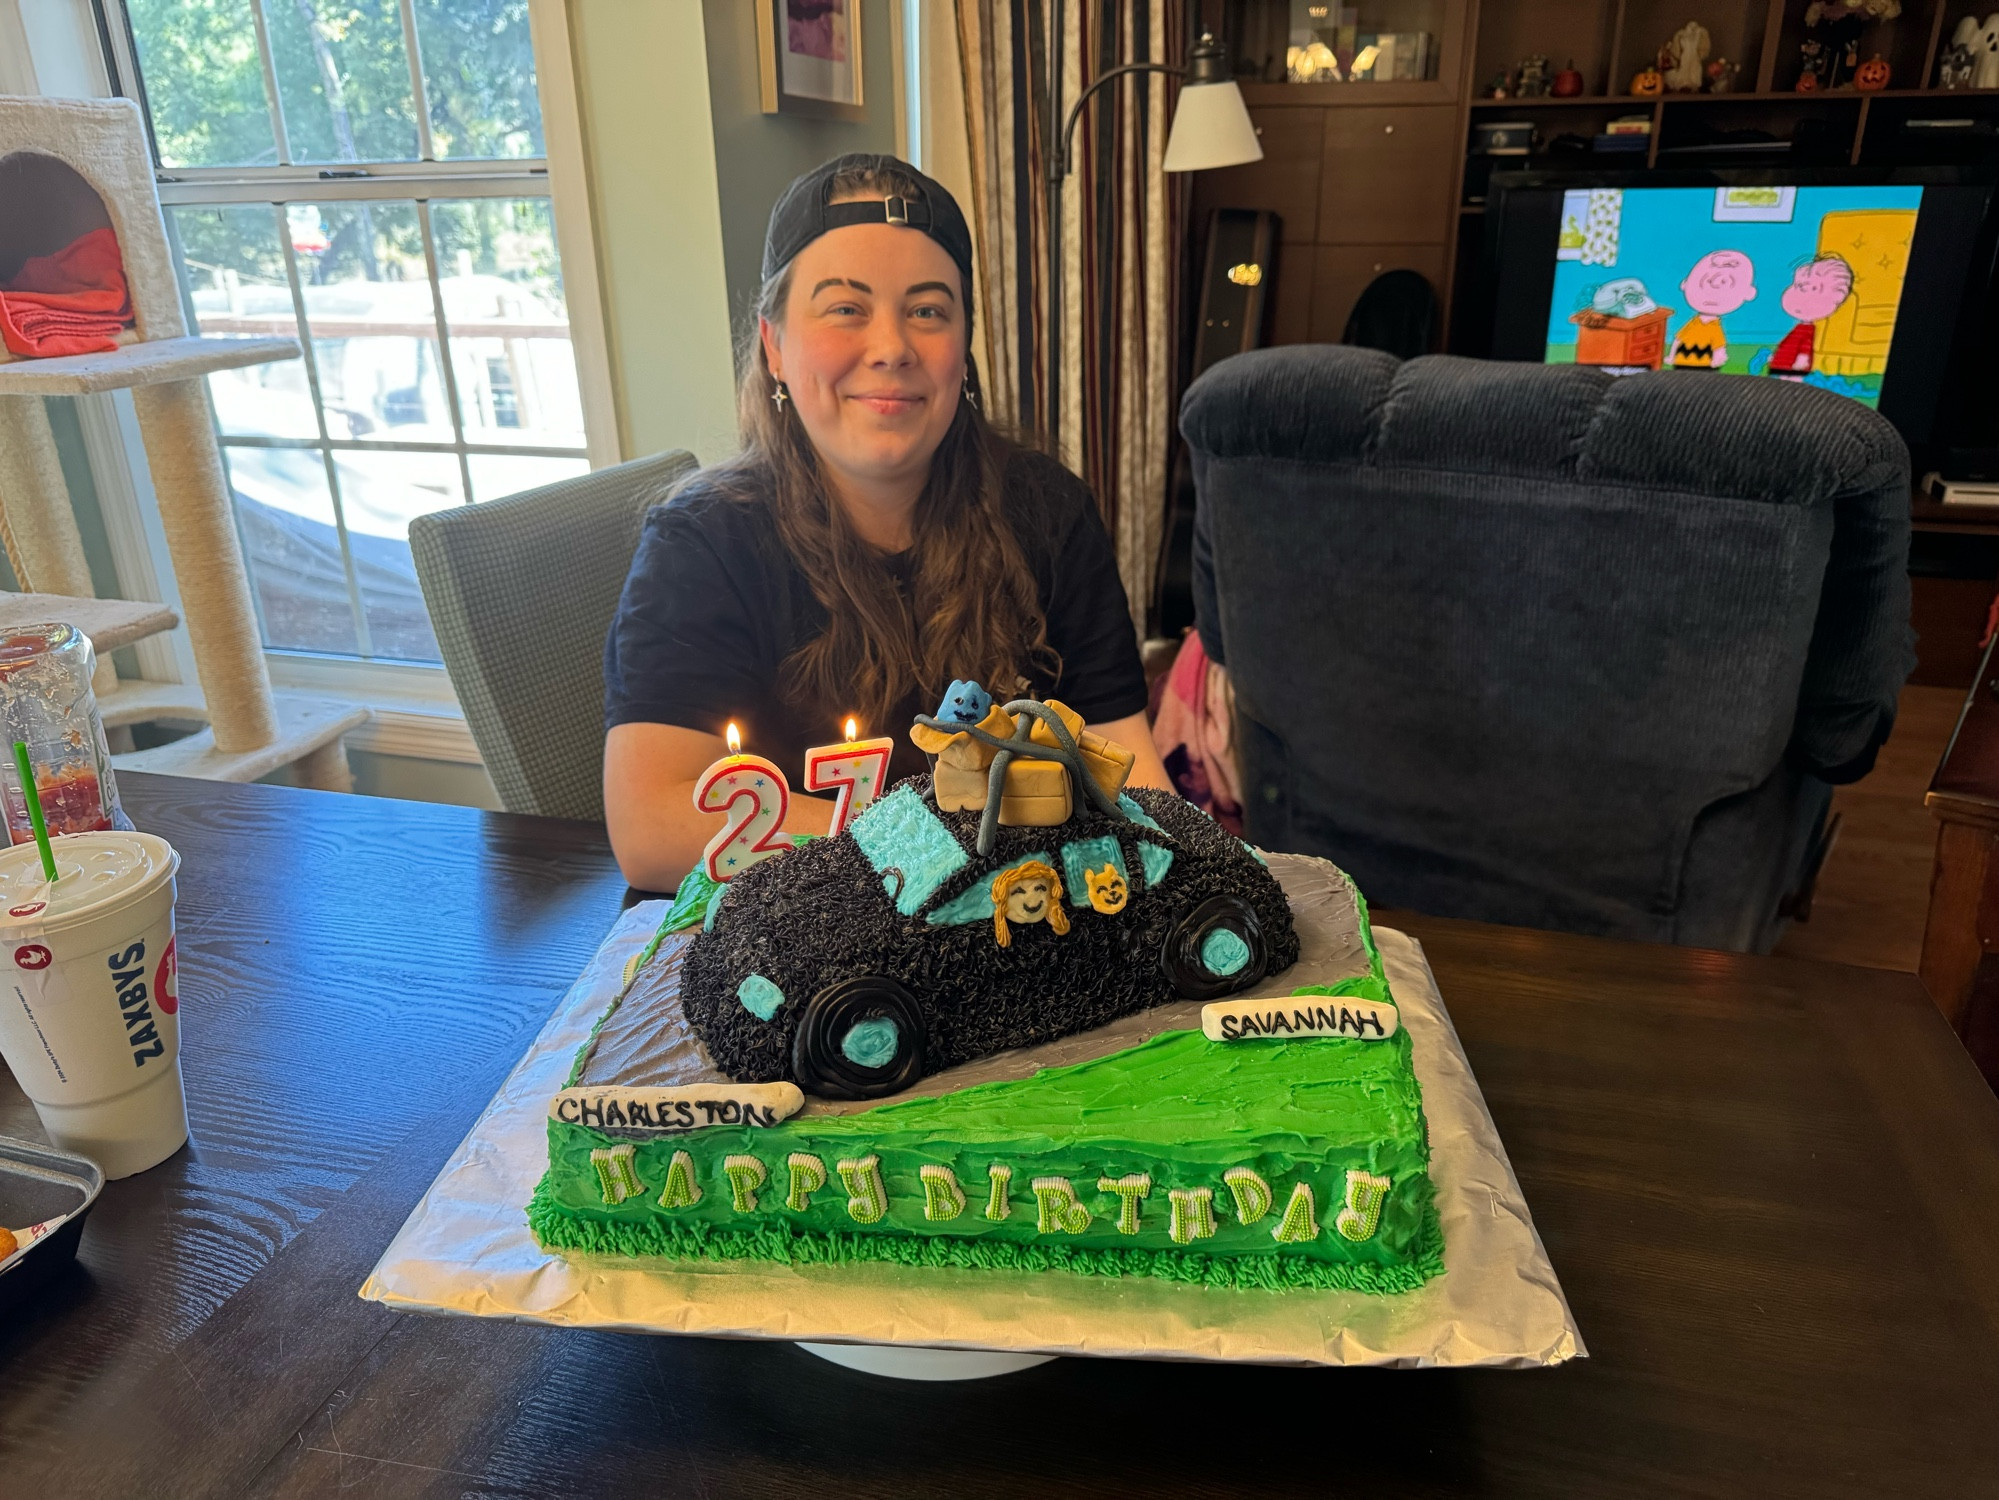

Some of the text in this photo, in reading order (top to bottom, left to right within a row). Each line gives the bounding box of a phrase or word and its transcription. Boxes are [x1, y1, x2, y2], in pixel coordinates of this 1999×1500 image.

[108, 941, 165, 1068] ZAXBYS
[1220, 1004, 1385, 1040] SAVANNAH
[557, 1097, 777, 1129] CHARLESTON
[590, 1144, 1391, 1244] HAPPY BIRTHDAY
